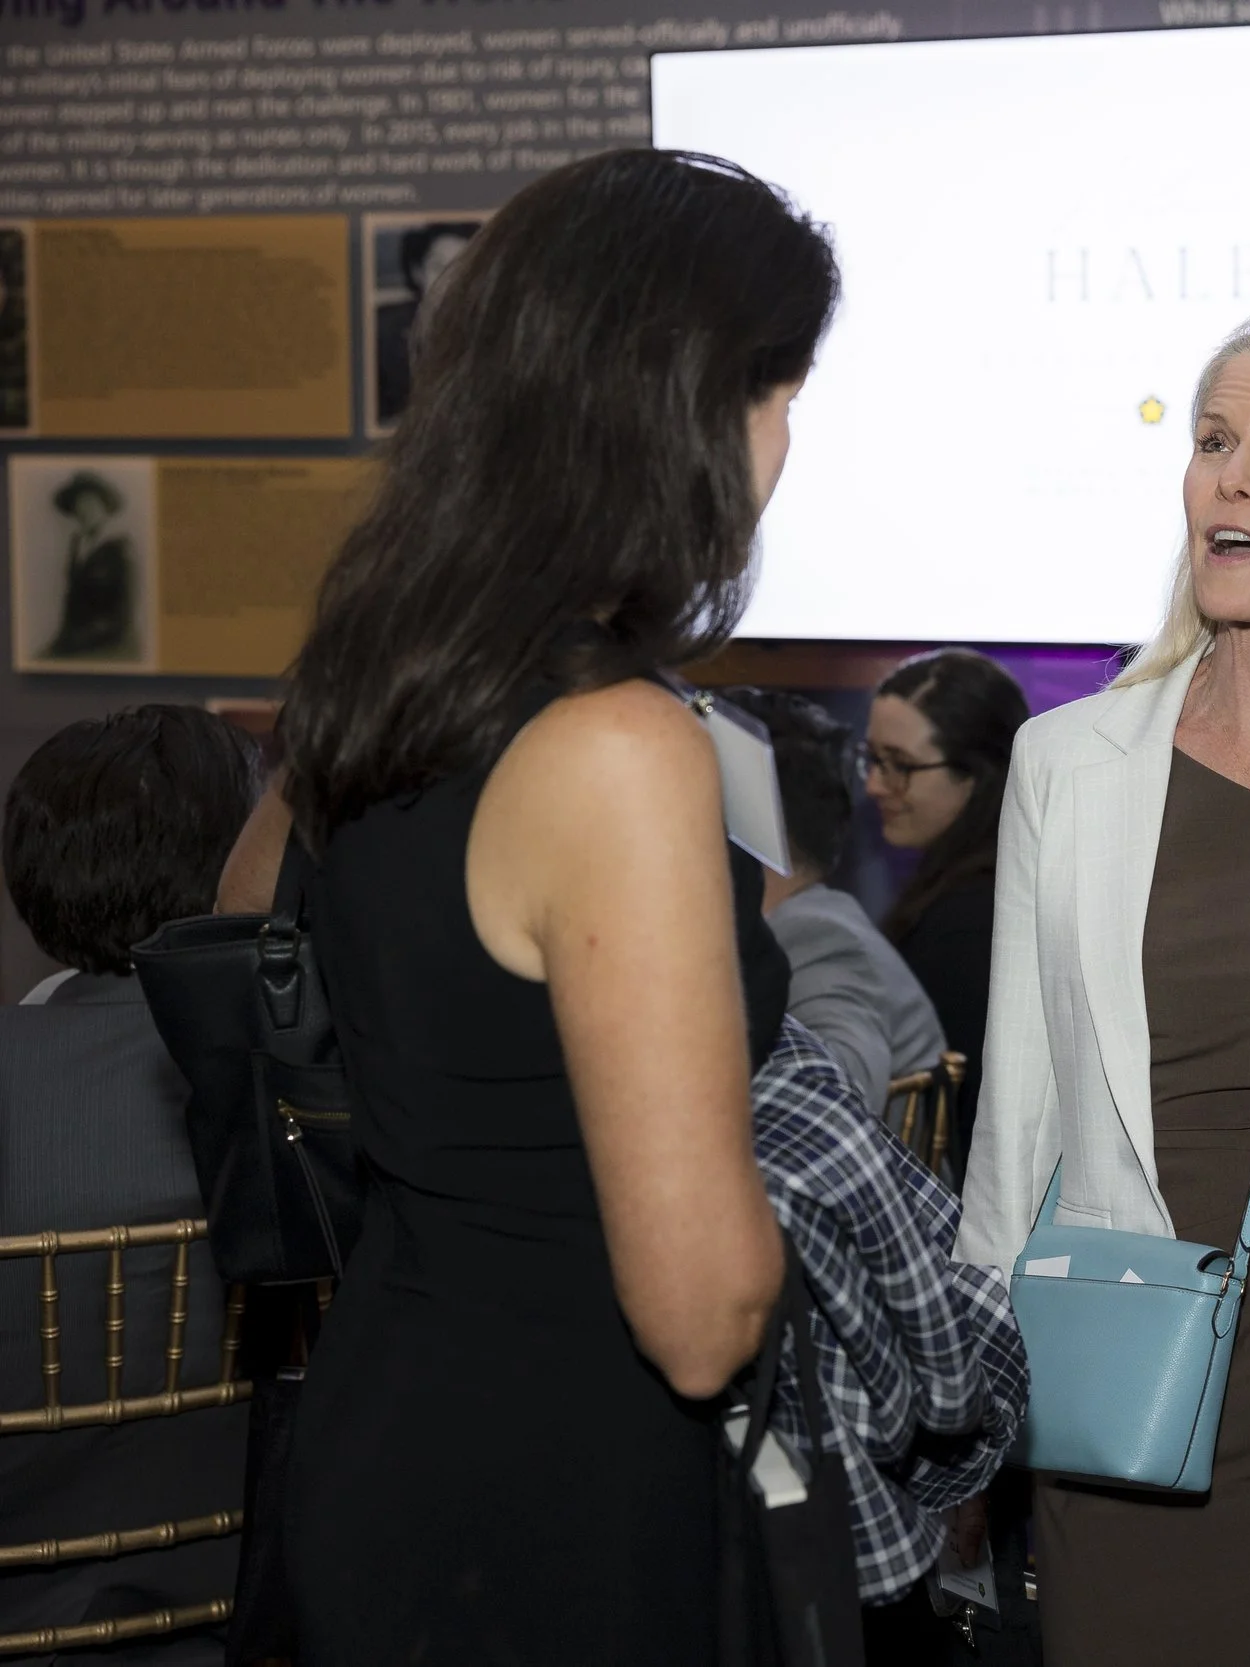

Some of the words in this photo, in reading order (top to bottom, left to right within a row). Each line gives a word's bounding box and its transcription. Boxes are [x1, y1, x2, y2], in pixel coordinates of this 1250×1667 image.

[45, 42, 112, 66] United
[114, 39, 175, 63] States
[179, 35, 248, 60] Armed
[251, 33, 317, 59] Forces
[319, 35, 373, 57] were
[376, 29, 477, 58] deployed,
[480, 27, 562, 50] women
[733, 16, 778, 47] and
[212, 65, 237, 90] of
[239, 62, 339, 93] deploying
[340, 63, 417, 86] women
[419, 58, 460, 84] due
[461, 59, 487, 83] to
[527, 55, 554, 80] of
[168, 94, 209, 121] and
[254, 92, 294, 119] the
[483, 90, 564, 111] women
[566, 84, 599, 109] for
[27, 130, 61, 154] the
[62, 126, 137, 156] military
[442, 120, 501, 148] every
[564, 114, 603, 140] the
[90, 159, 108, 181] is
[109, 154, 189, 186] through
[191, 154, 227, 180] the
[335, 150, 377, 177] and
[430, 149, 484, 174] work
[485, 147, 512, 173] of
[195, 181, 312, 215] generations
[312, 178, 338, 208] of
